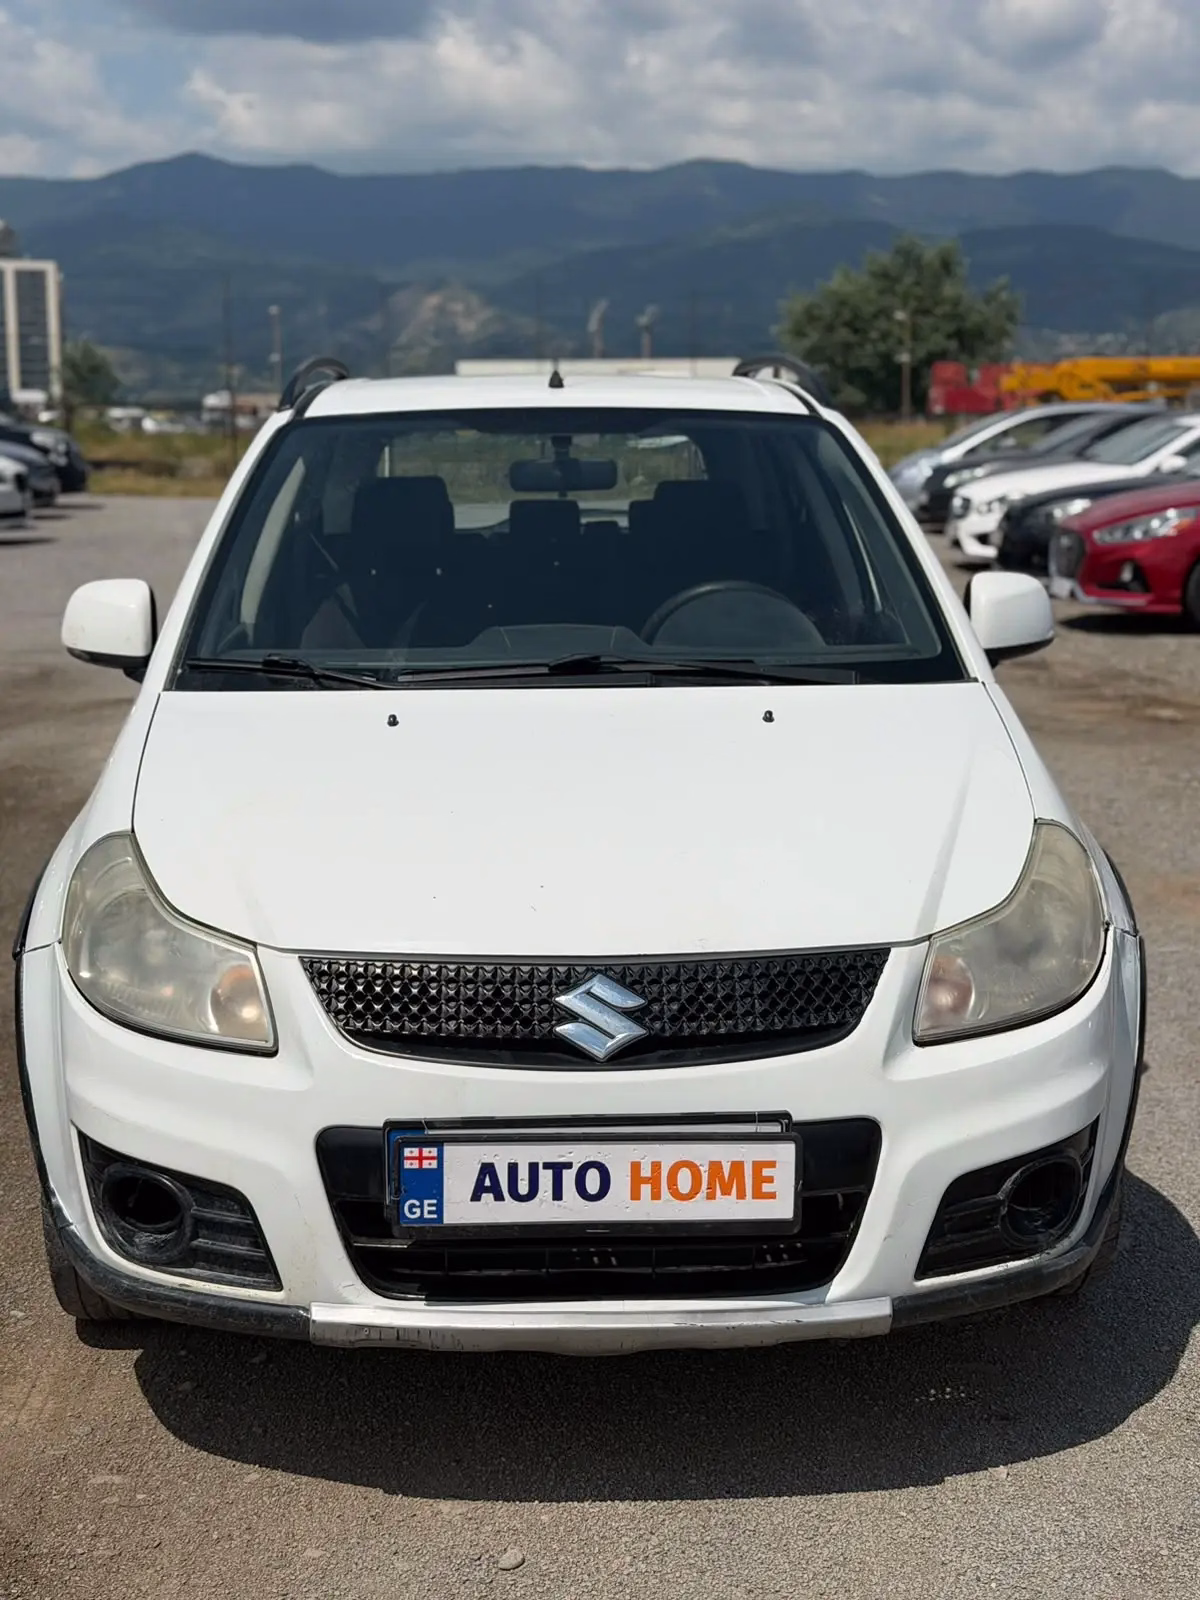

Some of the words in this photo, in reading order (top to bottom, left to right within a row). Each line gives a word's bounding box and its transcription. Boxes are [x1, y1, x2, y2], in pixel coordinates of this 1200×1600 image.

[470, 1160, 611, 1202] AUTO
[629, 1160, 777, 1202] HOME
[403, 1199, 438, 1219] GE
